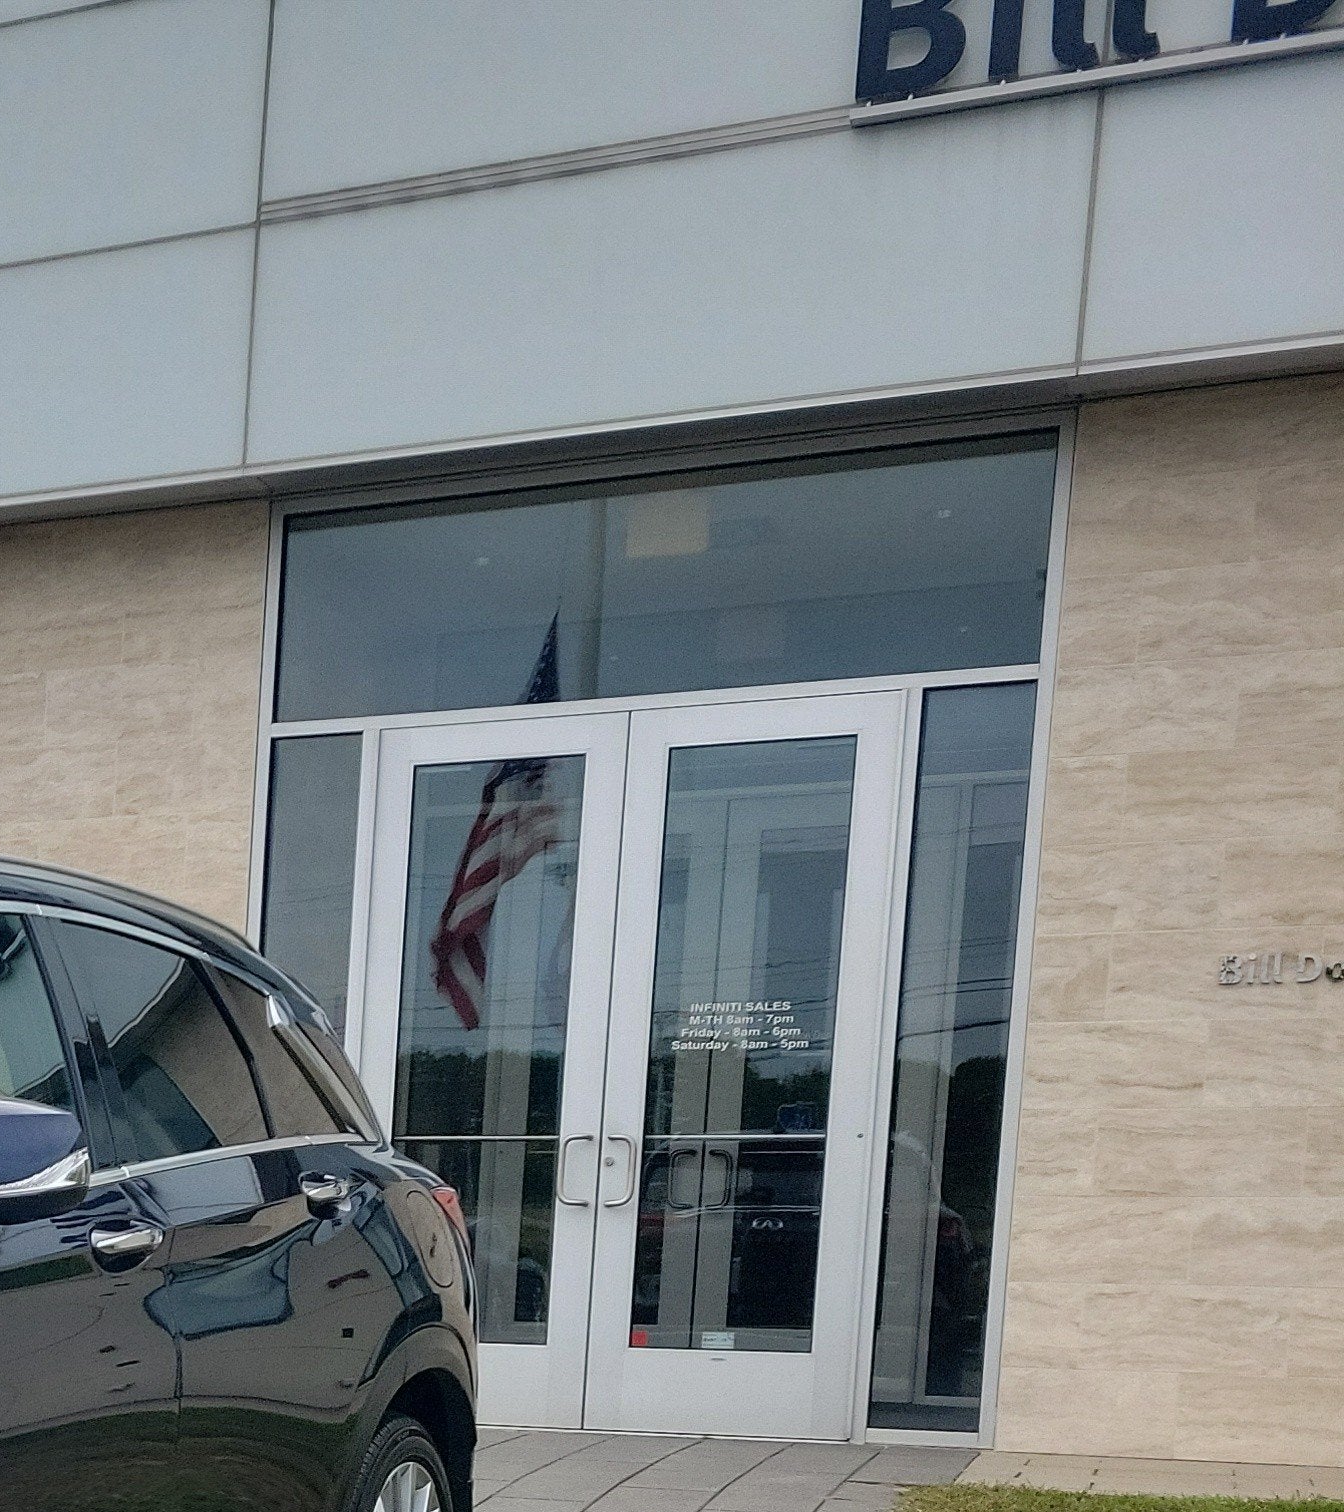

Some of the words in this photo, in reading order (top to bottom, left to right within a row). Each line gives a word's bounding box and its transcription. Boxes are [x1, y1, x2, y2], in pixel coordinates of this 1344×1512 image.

[1217, 952, 1283, 986] Bill
[690, 1001, 742, 1013] INFINITI
[745, 1000, 792, 1012] SALES
[689, 1014, 723, 1026] M-TH
[726, 1014, 754, 1025] 8am
[766, 1013, 794, 1026] 7pm
[681, 1027, 722, 1040] Friday
[732, 1027, 760, 1037] 8am
[772, 1026, 801, 1038] 6pm
[671, 1040, 729, 1052] Saturday
[740, 1039, 769, 1050] 8am
[780, 1038, 809, 1051] 5pm
